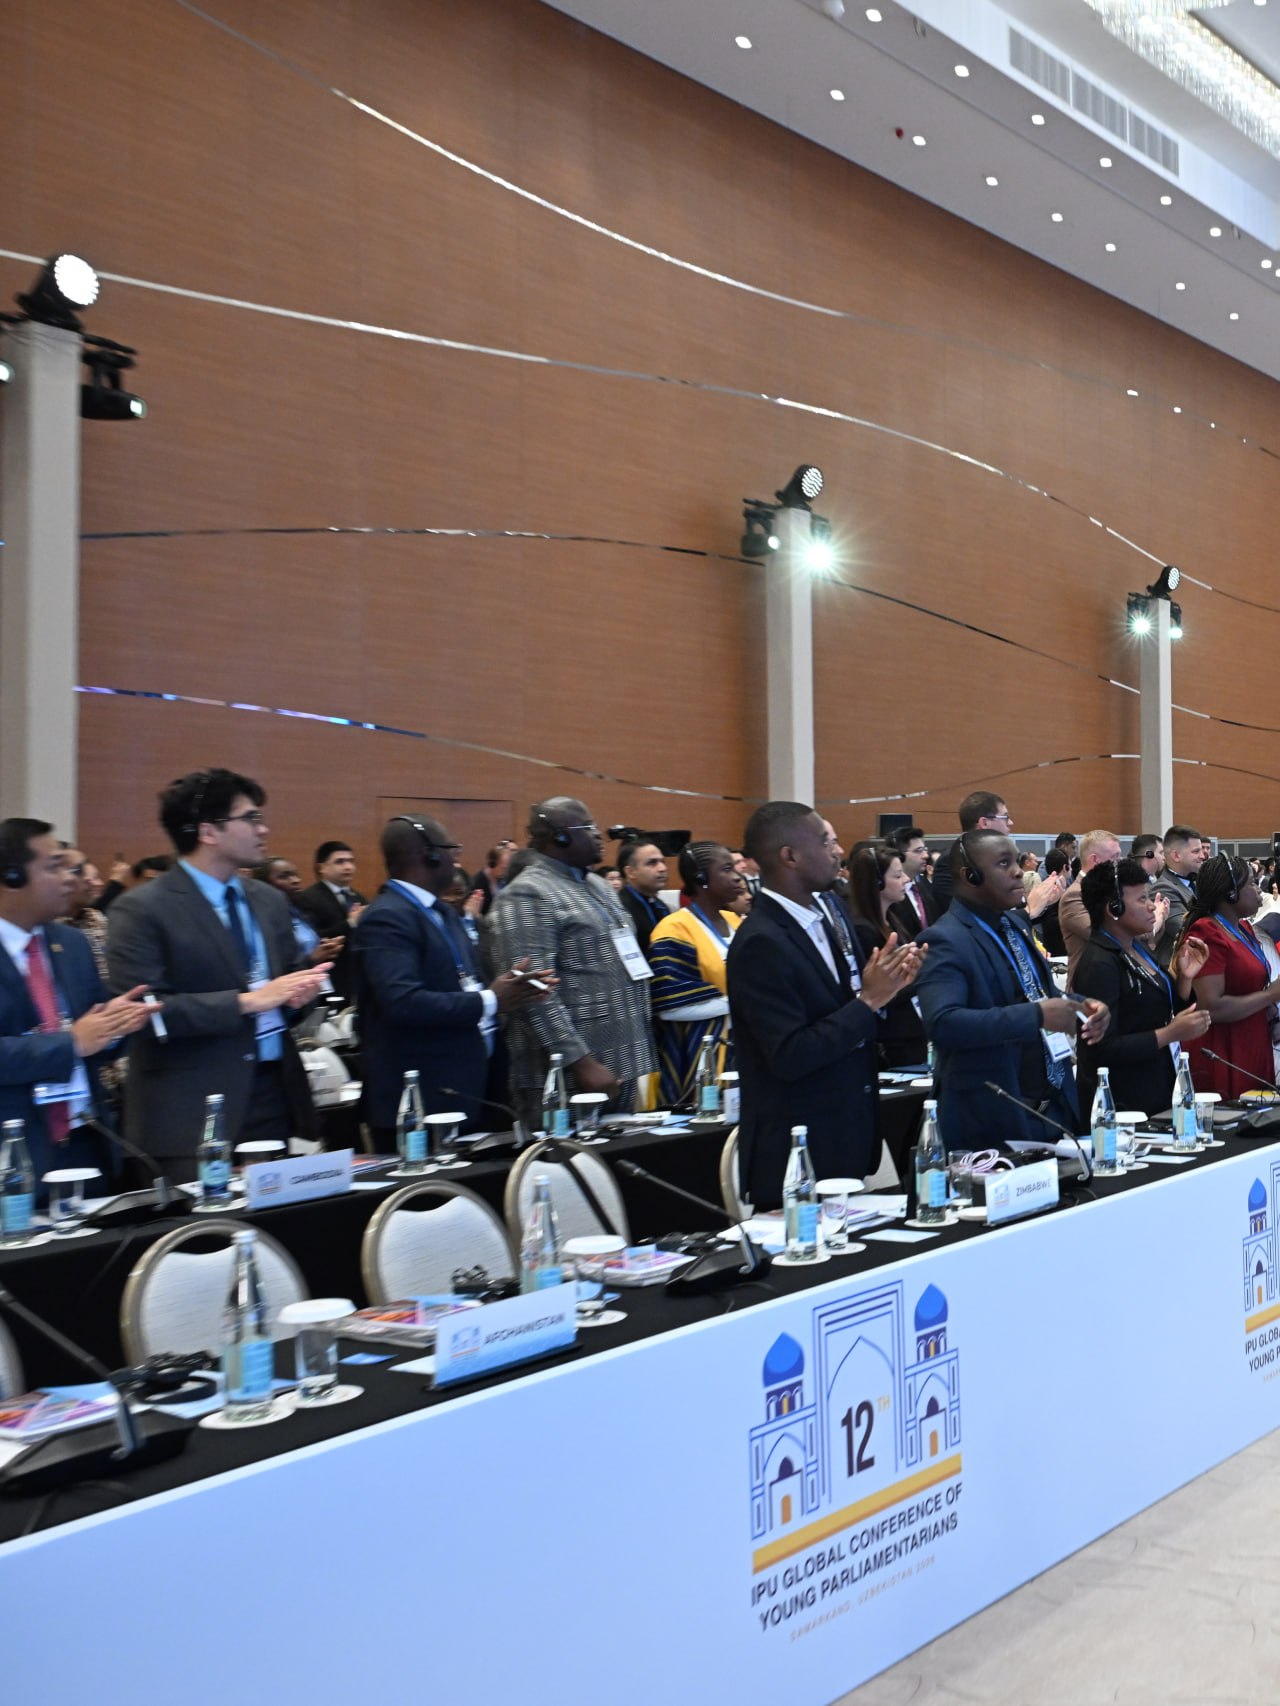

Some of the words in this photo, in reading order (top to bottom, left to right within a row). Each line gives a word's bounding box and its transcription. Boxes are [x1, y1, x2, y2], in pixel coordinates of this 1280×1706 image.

[1245, 1338, 1257, 1356] IPU
[1249, 1348, 1275, 1373] YOUNG
[841, 1400, 875, 1478] 12
[751, 1575, 778, 1608] IPU
[783, 1542, 846, 1590] GLOBAL
[849, 1493, 943, 1555] CONFERENCE
[945, 1482, 963, 1506] OF
[760, 1586, 817, 1633] YOUNG
[820, 1511, 959, 1601] PARLIAMENTARIANS
